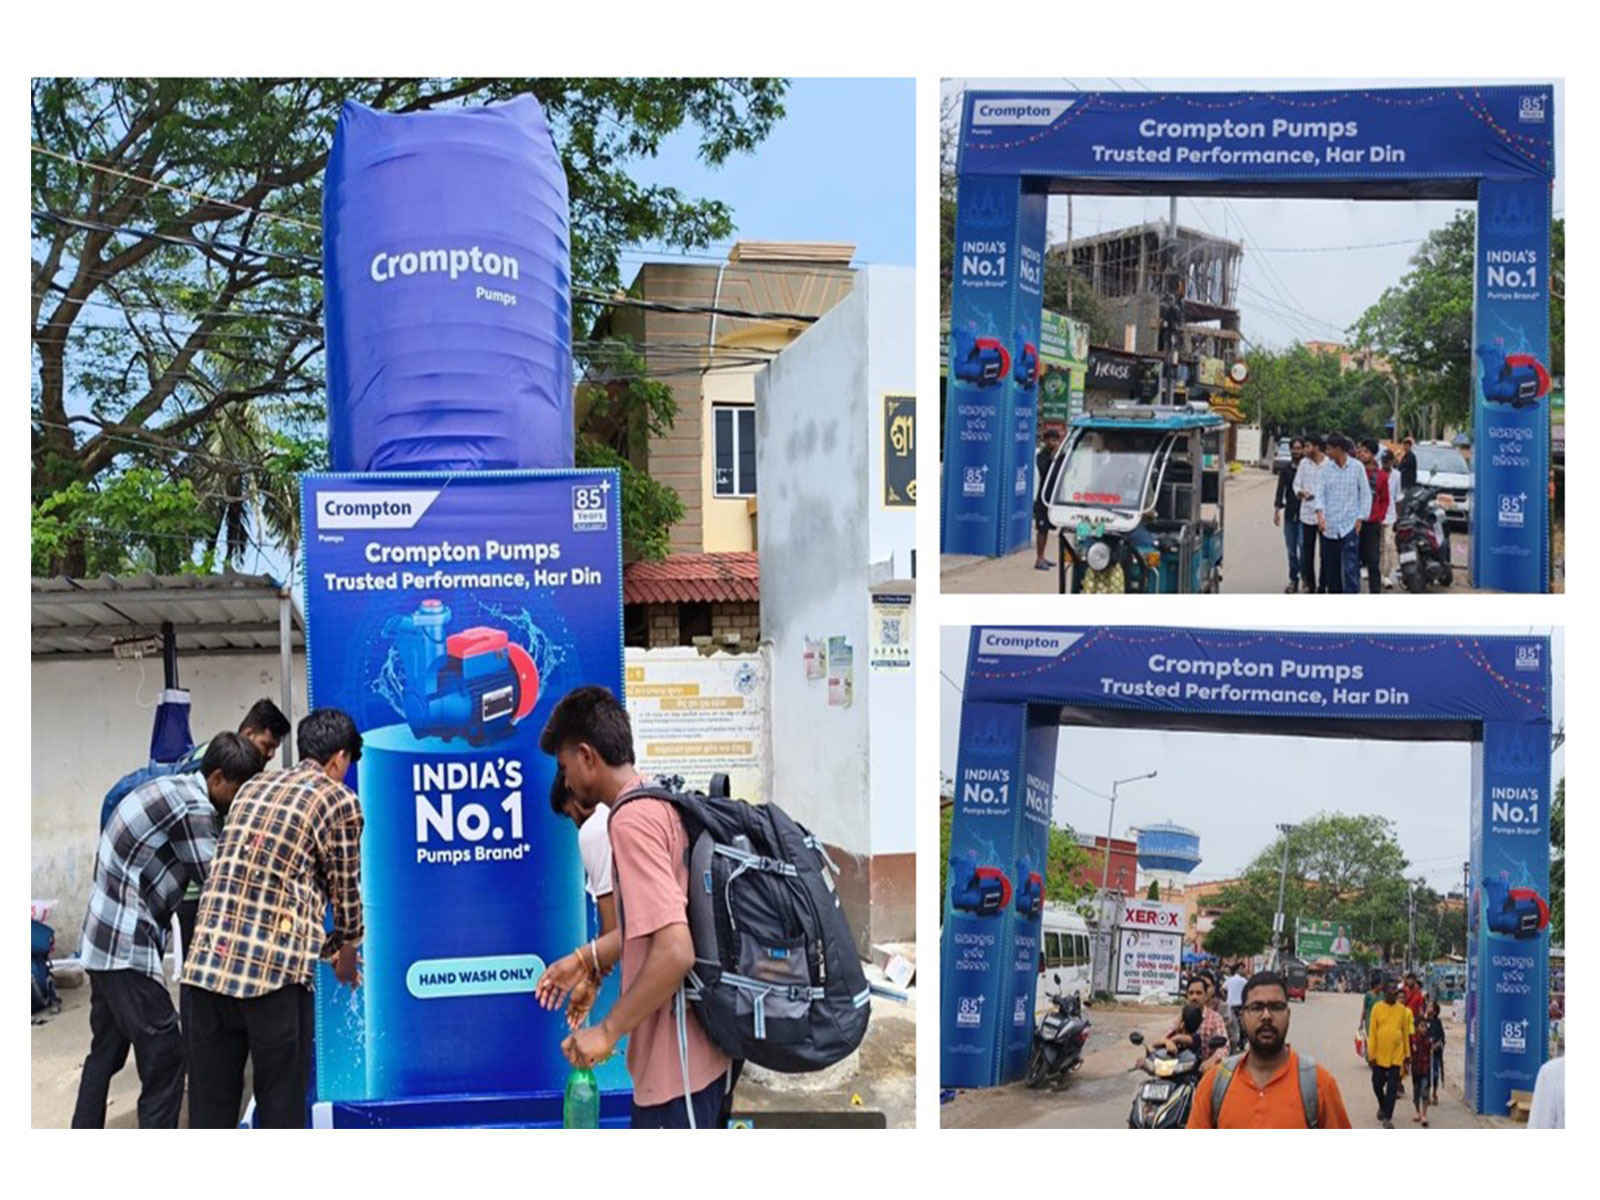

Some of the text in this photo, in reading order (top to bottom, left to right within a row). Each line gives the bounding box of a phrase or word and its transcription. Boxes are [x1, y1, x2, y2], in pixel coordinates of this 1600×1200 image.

[979, 101, 1051, 119] Crompton
[1139, 118, 1358, 142] Crompton Pumps
[1092, 145, 1406, 166] Trusted Performance, Har Din
[963, 241, 1007, 255] INDIA'S
[1486, 249, 1537, 264] INDIA'S
[371, 246, 519, 282] Crompton
[962, 255, 1006, 277] No.1
[1487, 266, 1536, 288] No.1
[476, 286, 517, 306] Pumps
[324, 499, 413, 519] Crompton
[318, 534, 345, 543] Pumps
[365, 540, 561, 567] Crompton Pumps
[324, 567, 602, 591] Trusted Performance, Har Din
[986, 634, 1059, 650] Crompton
[1148, 654, 1364, 684] Crompton Pumps
[1101, 678, 1409, 706] Trusted Performance, Har Din
[412, 757, 524, 792] INDIA'S
[965, 768, 1011, 782] INDIA'S
[963, 782, 1009, 804] No.1
[1492, 786, 1539, 801] INDIA'S
[415, 791, 524, 843] No.1
[1492, 801, 1538, 824] No.1
[416, 847, 471, 866] Pumps
[1124, 907, 1179, 927] XEROX
[419, 967, 534, 986] HAND WASH ONLY
